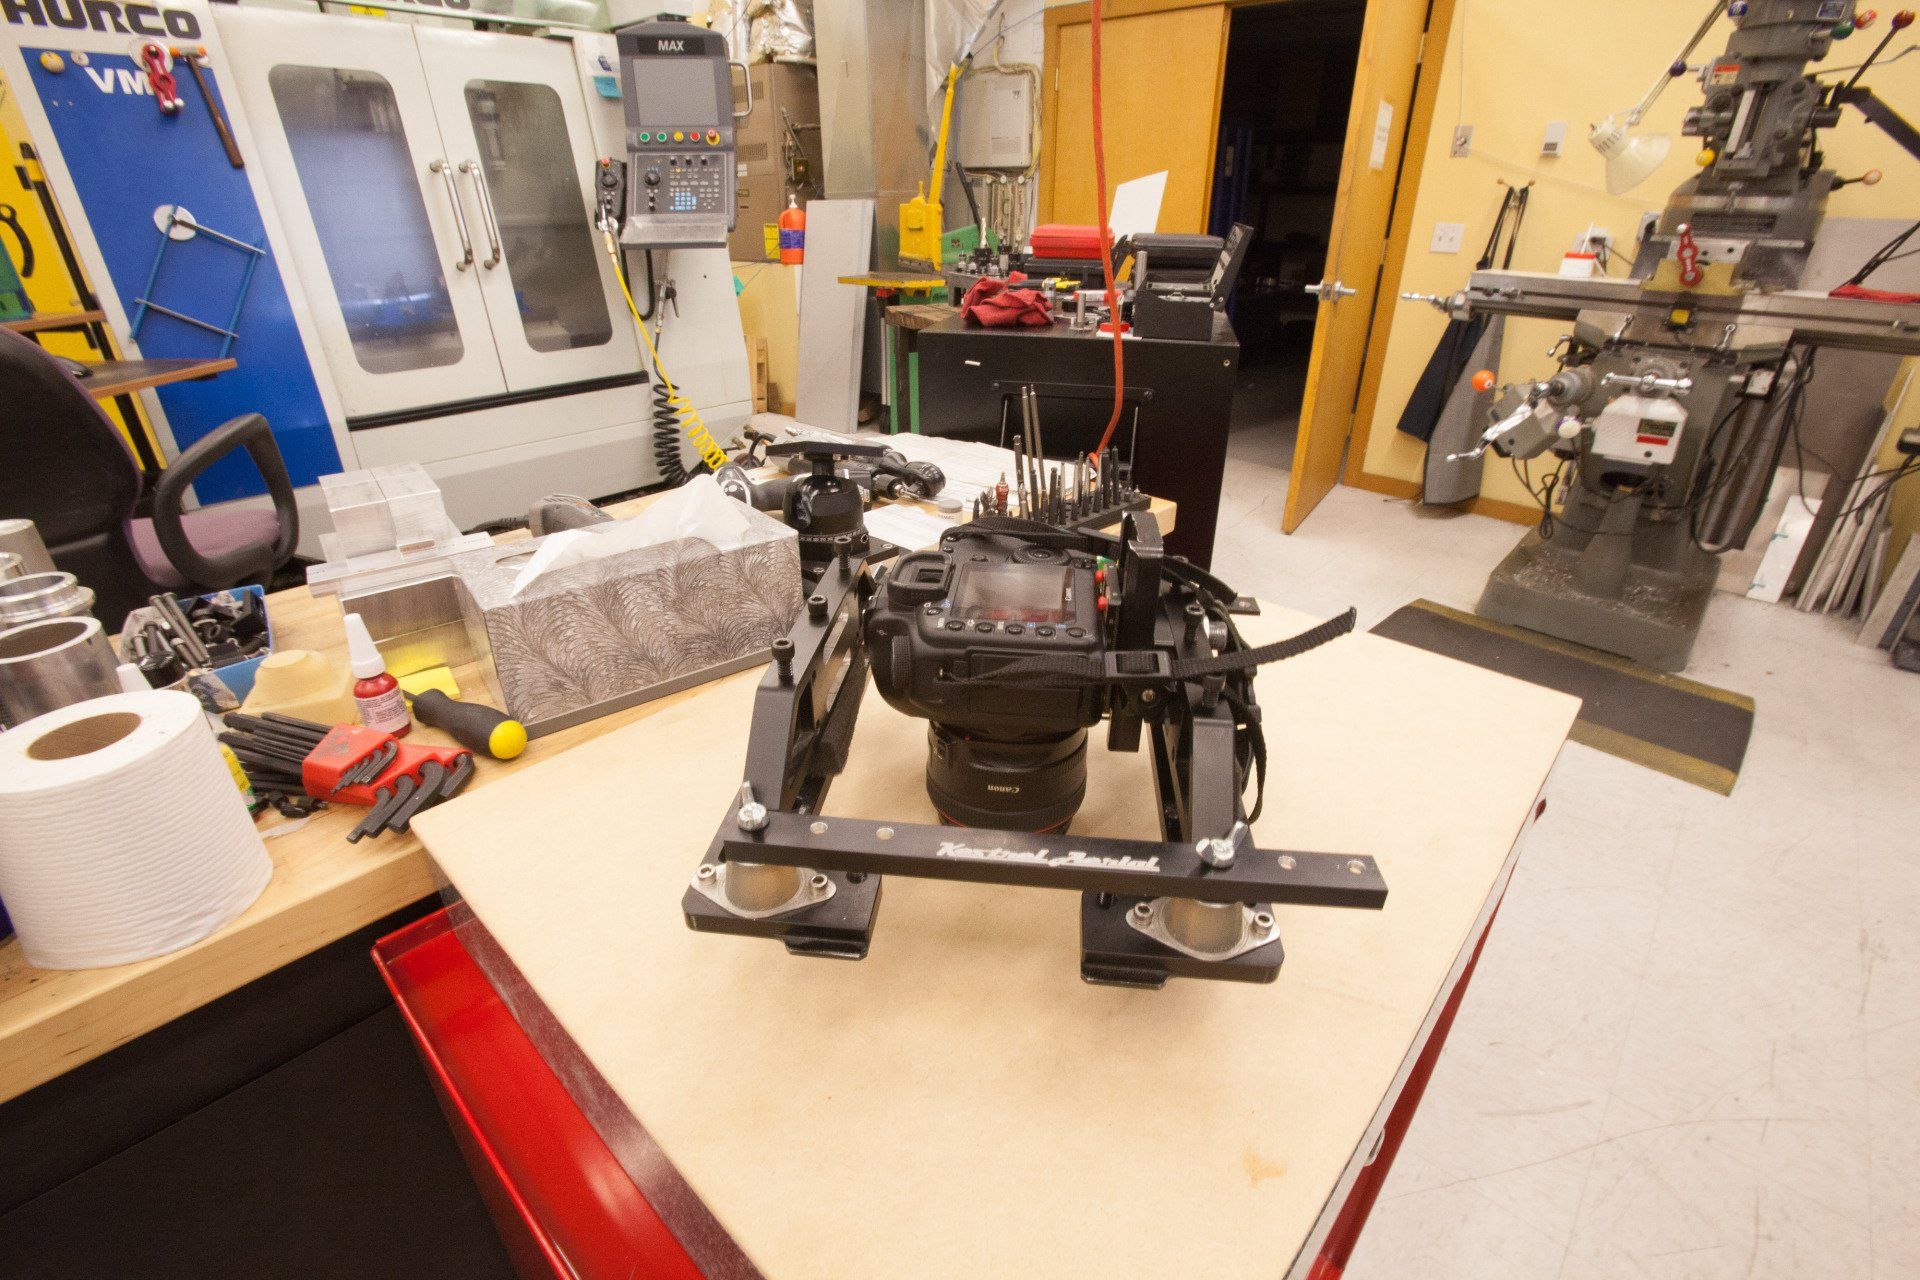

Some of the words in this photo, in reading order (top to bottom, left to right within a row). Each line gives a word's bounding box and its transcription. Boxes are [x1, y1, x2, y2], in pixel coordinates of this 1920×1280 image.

[0, 0, 202, 39] HURCO
[658, 39, 684, 52] MAX
[986, 784, 1021, 795] Canon
